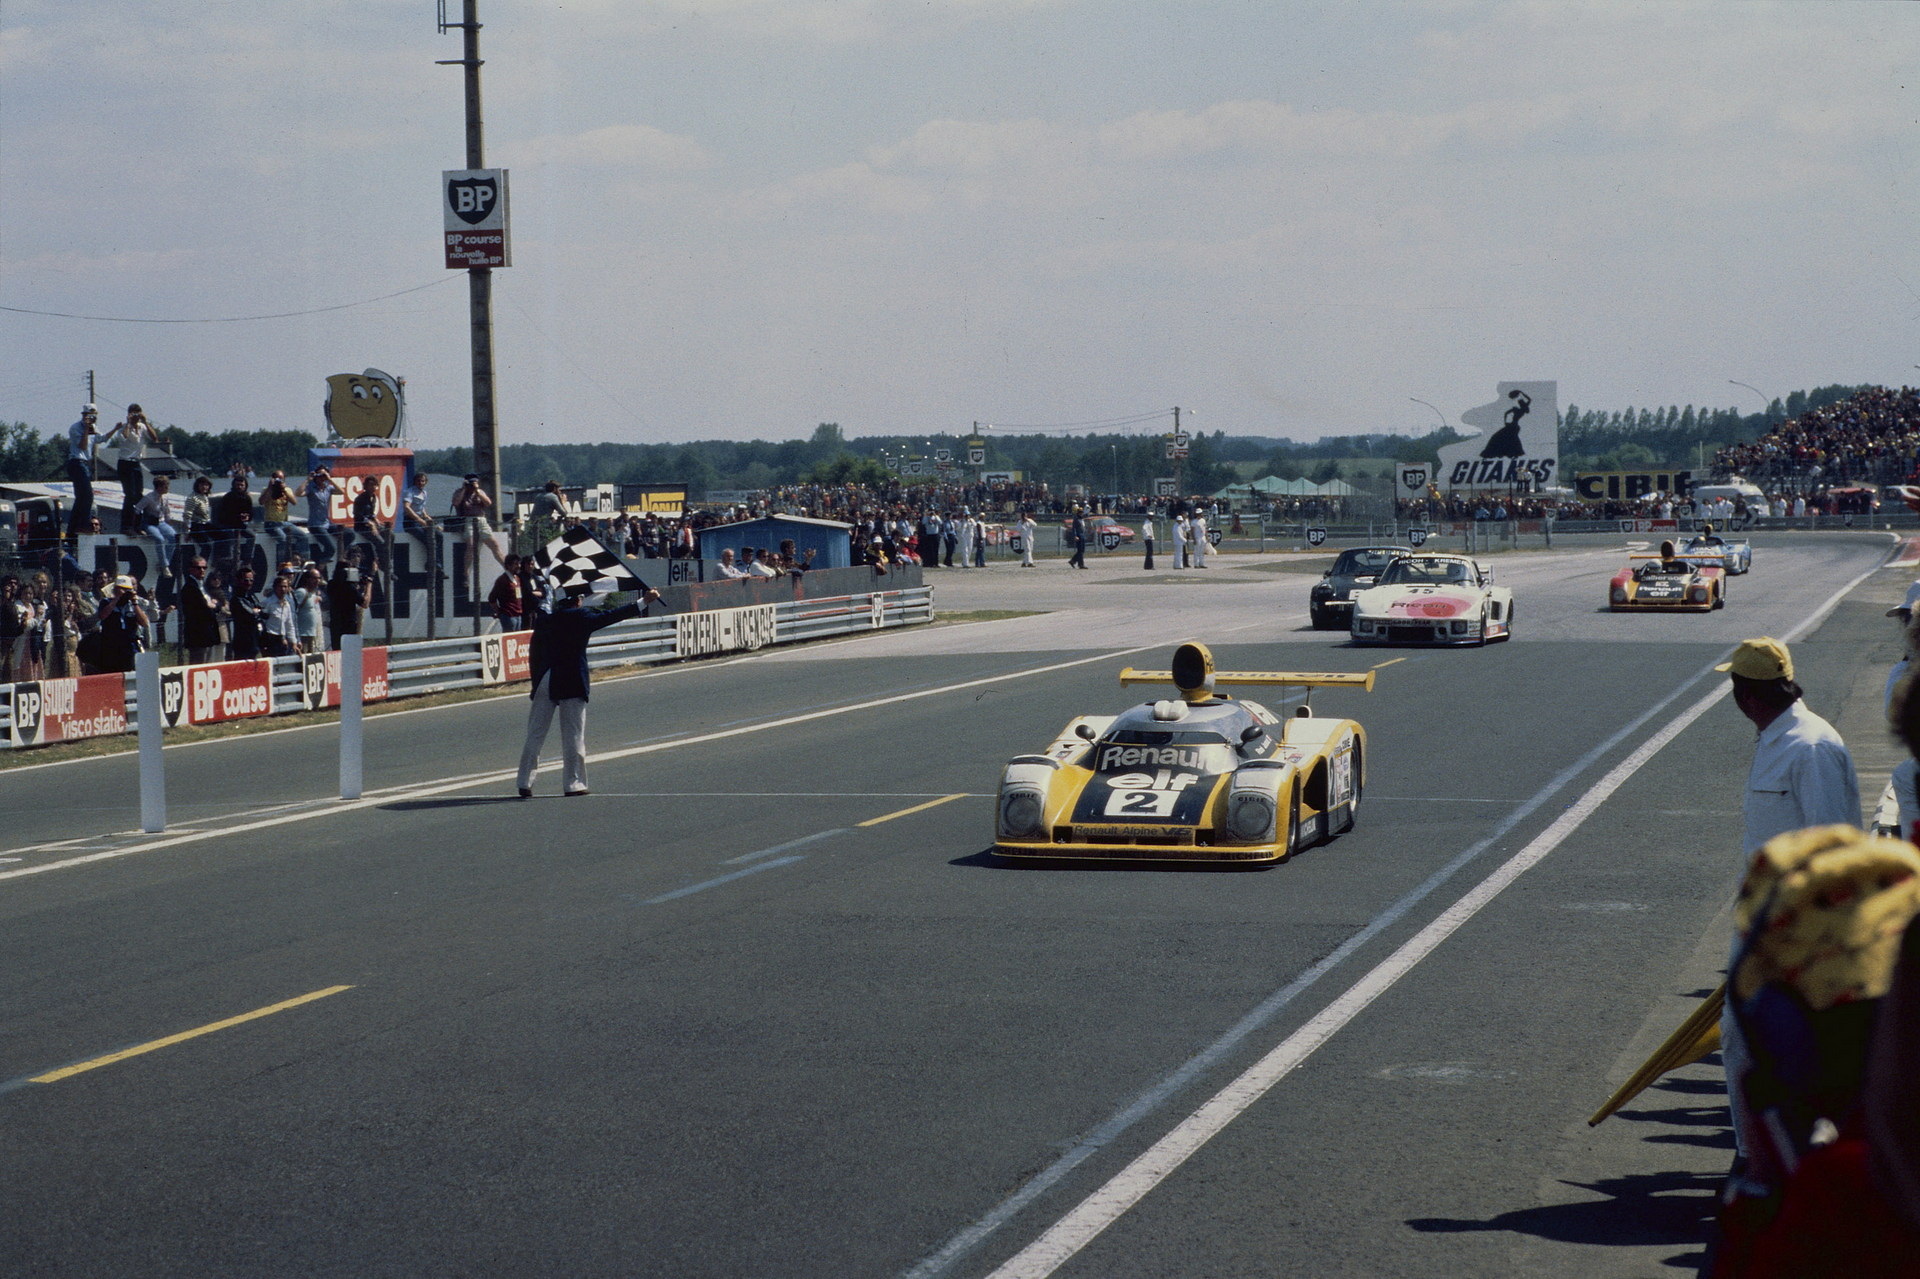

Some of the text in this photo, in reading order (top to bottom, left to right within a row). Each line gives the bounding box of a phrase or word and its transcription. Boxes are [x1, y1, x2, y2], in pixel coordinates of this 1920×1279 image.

[456, 185, 493, 212] BP
[447, 234, 501, 245] BP course
[1406, 472, 1426, 486] BP
[1450, 458, 1555, 486] GITANES
[331, 475, 397, 520] ESO
[1160, 485, 1176, 496] BP
[1104, 535, 1119, 546] BP
[1309, 532, 1325, 542] BP
[1411, 532, 1427, 543] BP
[672, 562, 689, 582] elf
[680, 612, 723, 656] GENERAL
[733, 606, 774, 649] INCENDIE
[487, 644, 500, 668] BP
[506, 639, 518, 660] BP
[306, 662, 325, 694] BP
[363, 675, 387, 699] static
[44, 678, 78, 723] super
[165, 681, 182, 713] BP
[193, 668, 267, 722] BP course
[18, 692, 40, 728] BP
[61, 708, 125, 739] visco static
[1101, 746, 1208, 771] Renaul
[1106, 769, 1199, 791] elf
[1121, 791, 1159, 813] 2
[1073, 825, 1118, 836] Renault
[1121, 826, 1158, 837] Alpine
